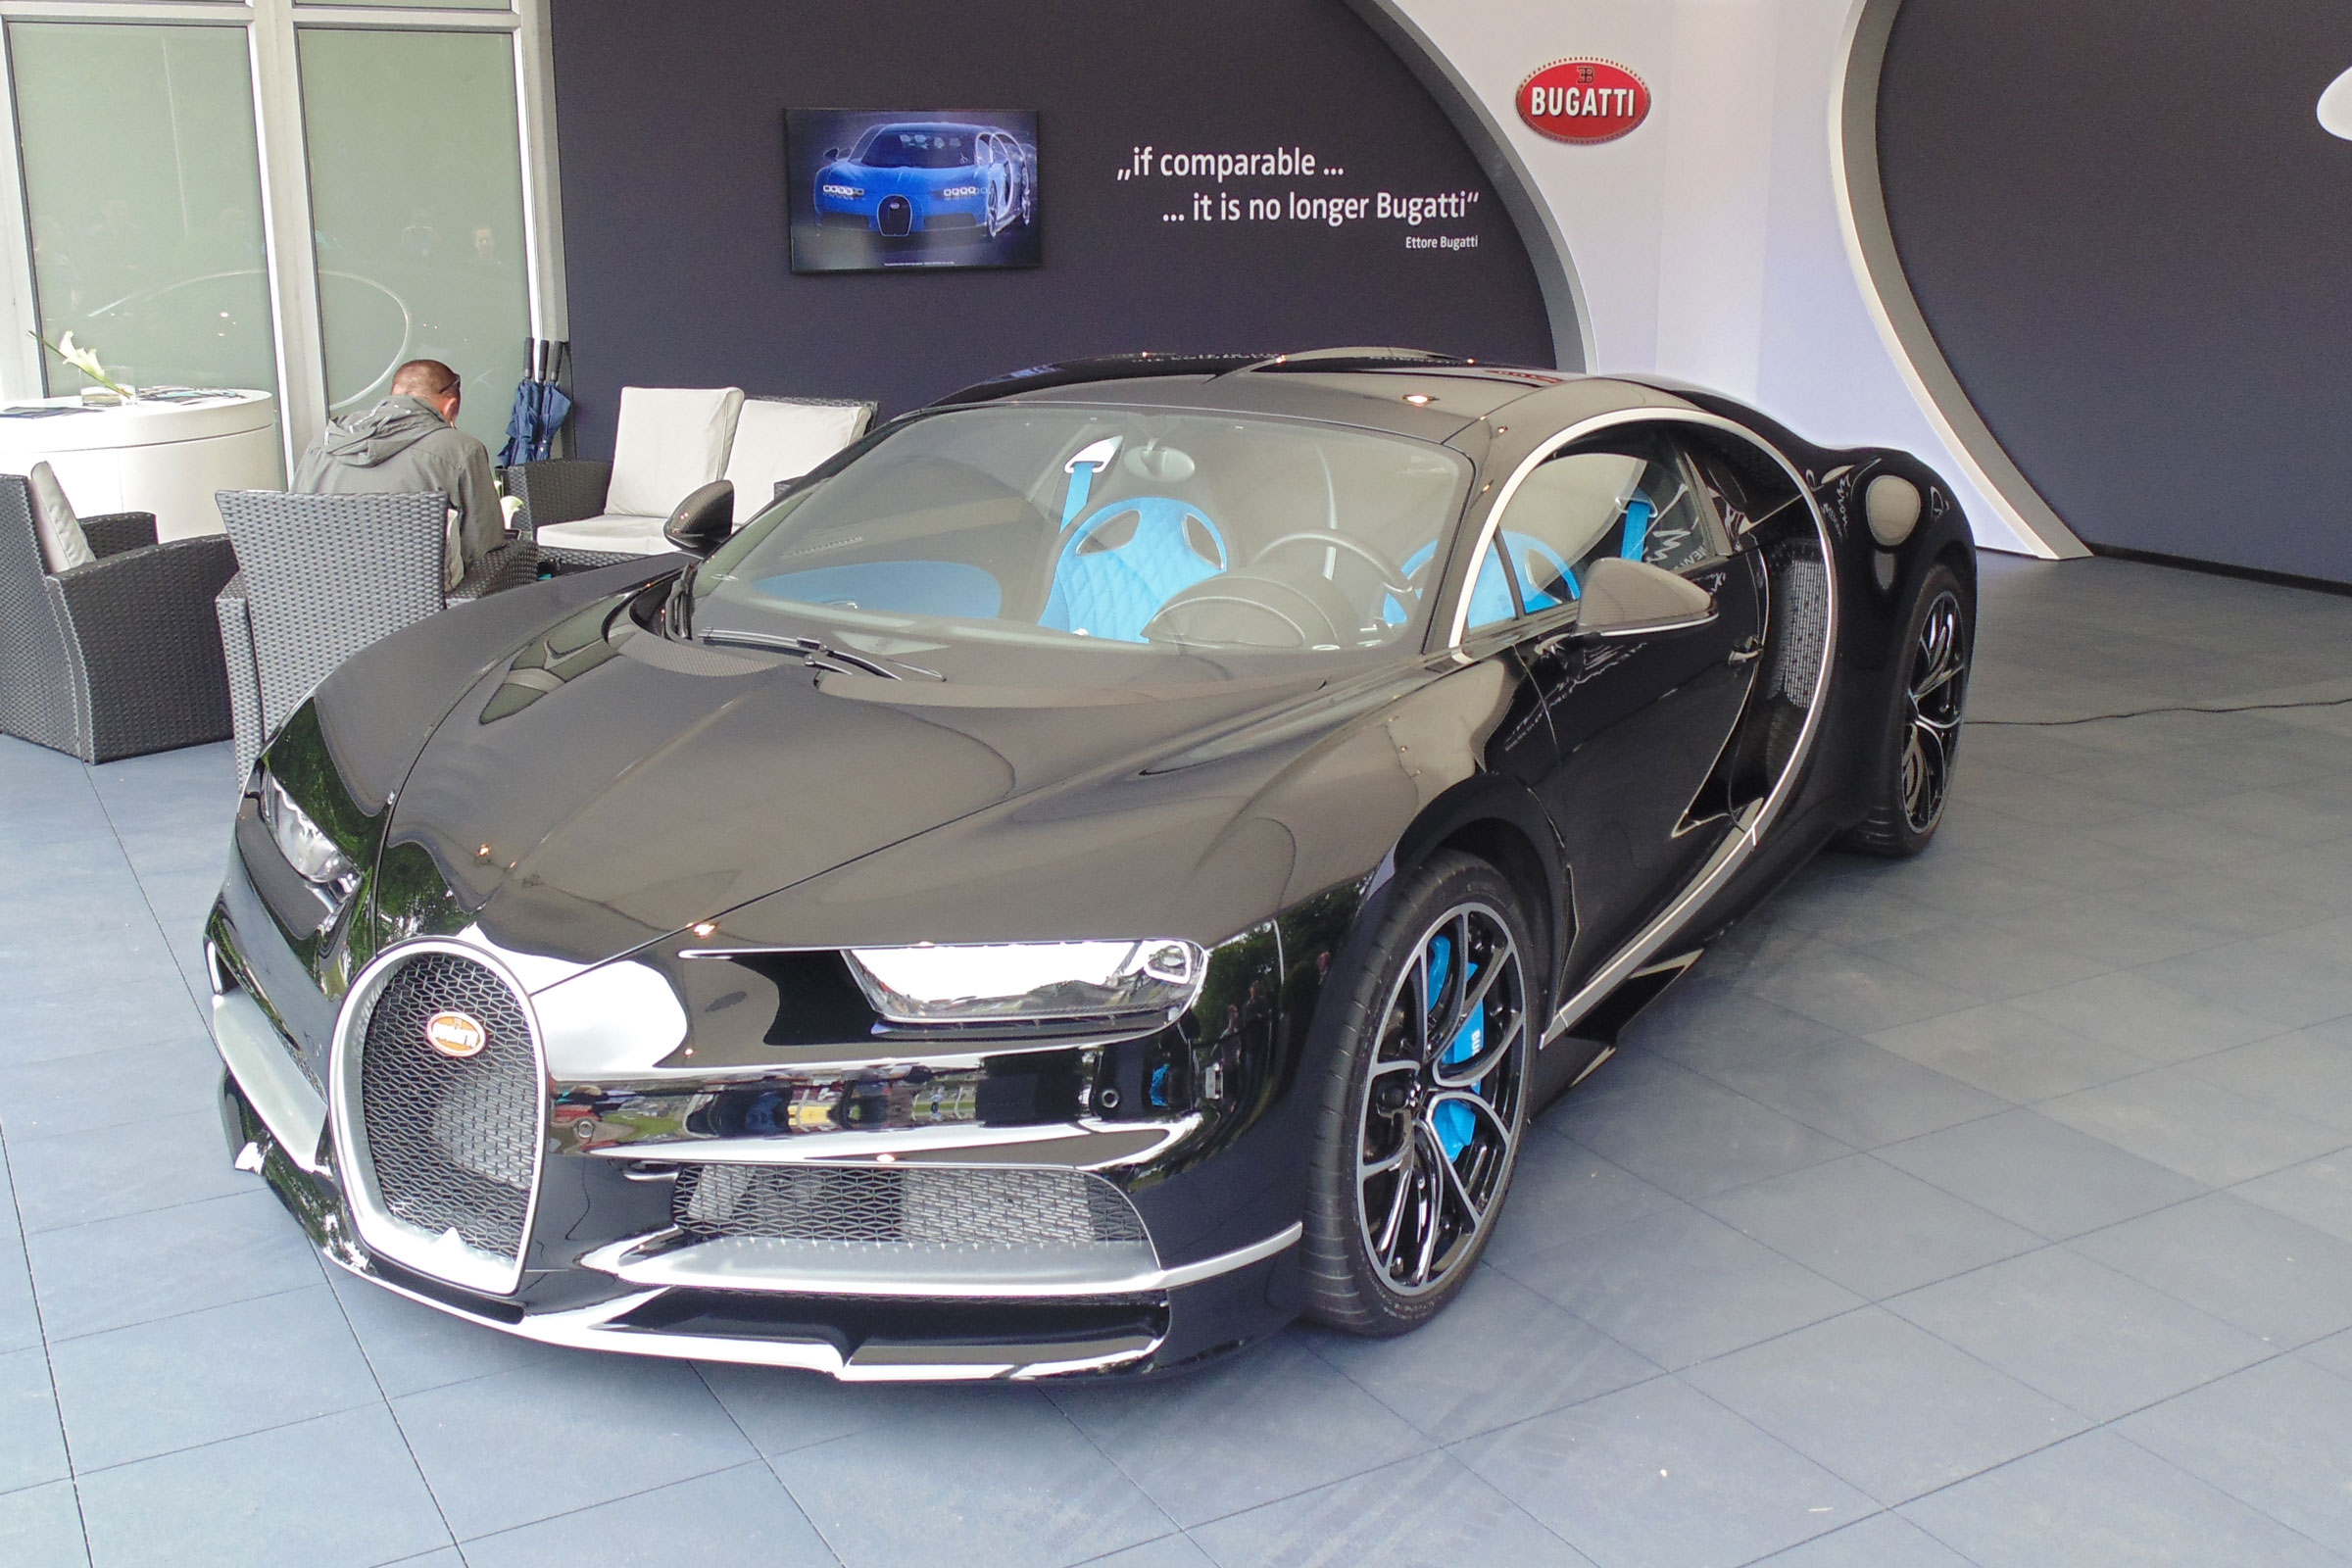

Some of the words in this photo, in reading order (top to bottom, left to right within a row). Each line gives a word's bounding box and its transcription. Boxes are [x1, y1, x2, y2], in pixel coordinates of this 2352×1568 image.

[1531, 86, 1635, 117] BUGATTI
[1159, 146, 1316, 183] comparable
[1193, 191, 1212, 221] it
[1220, 191, 1241, 221] is
[1249, 198, 1281, 220] no
[1289, 191, 1370, 227] longer
[1405, 236, 1439, 249] Ettore
[1440, 235, 1479, 251] Bugatti
